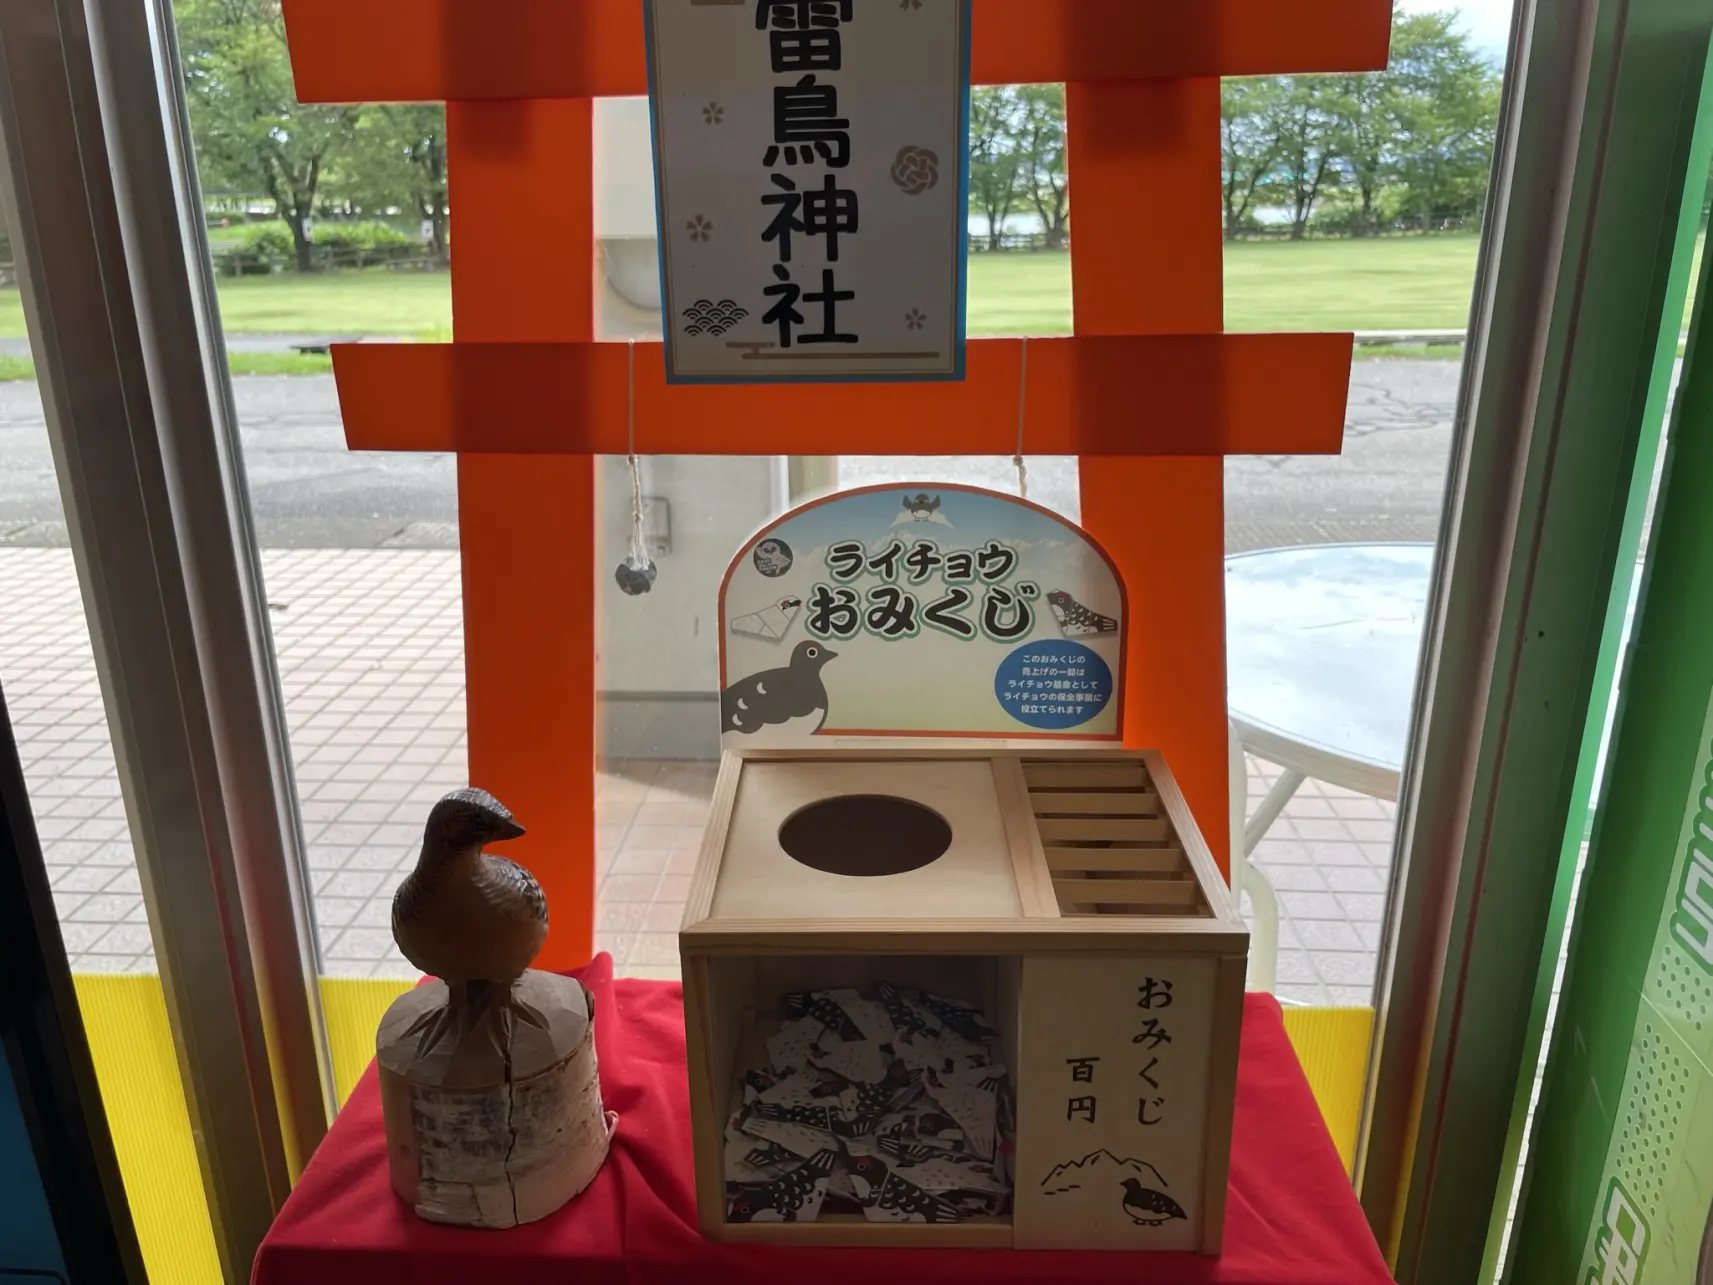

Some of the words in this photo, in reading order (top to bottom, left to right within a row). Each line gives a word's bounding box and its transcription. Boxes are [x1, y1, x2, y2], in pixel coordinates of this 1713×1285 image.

[755, 0, 859, 348] 雷鳥神社
[828, 542, 1016, 581] ライチョウ
[808, 584, 1038, 638] おみくじ
[1021, 667, 1085, 677] 売上げの一部は
[1022, 654, 1086, 664] このおみくじの
[1008, 679, 1099, 690] ライチョウ基金として
[1020, 704, 1084, 714] 役立てられます
[1132, 976, 1174, 1126] おみくじ
[1066, 1056, 1101, 1124] 百円
